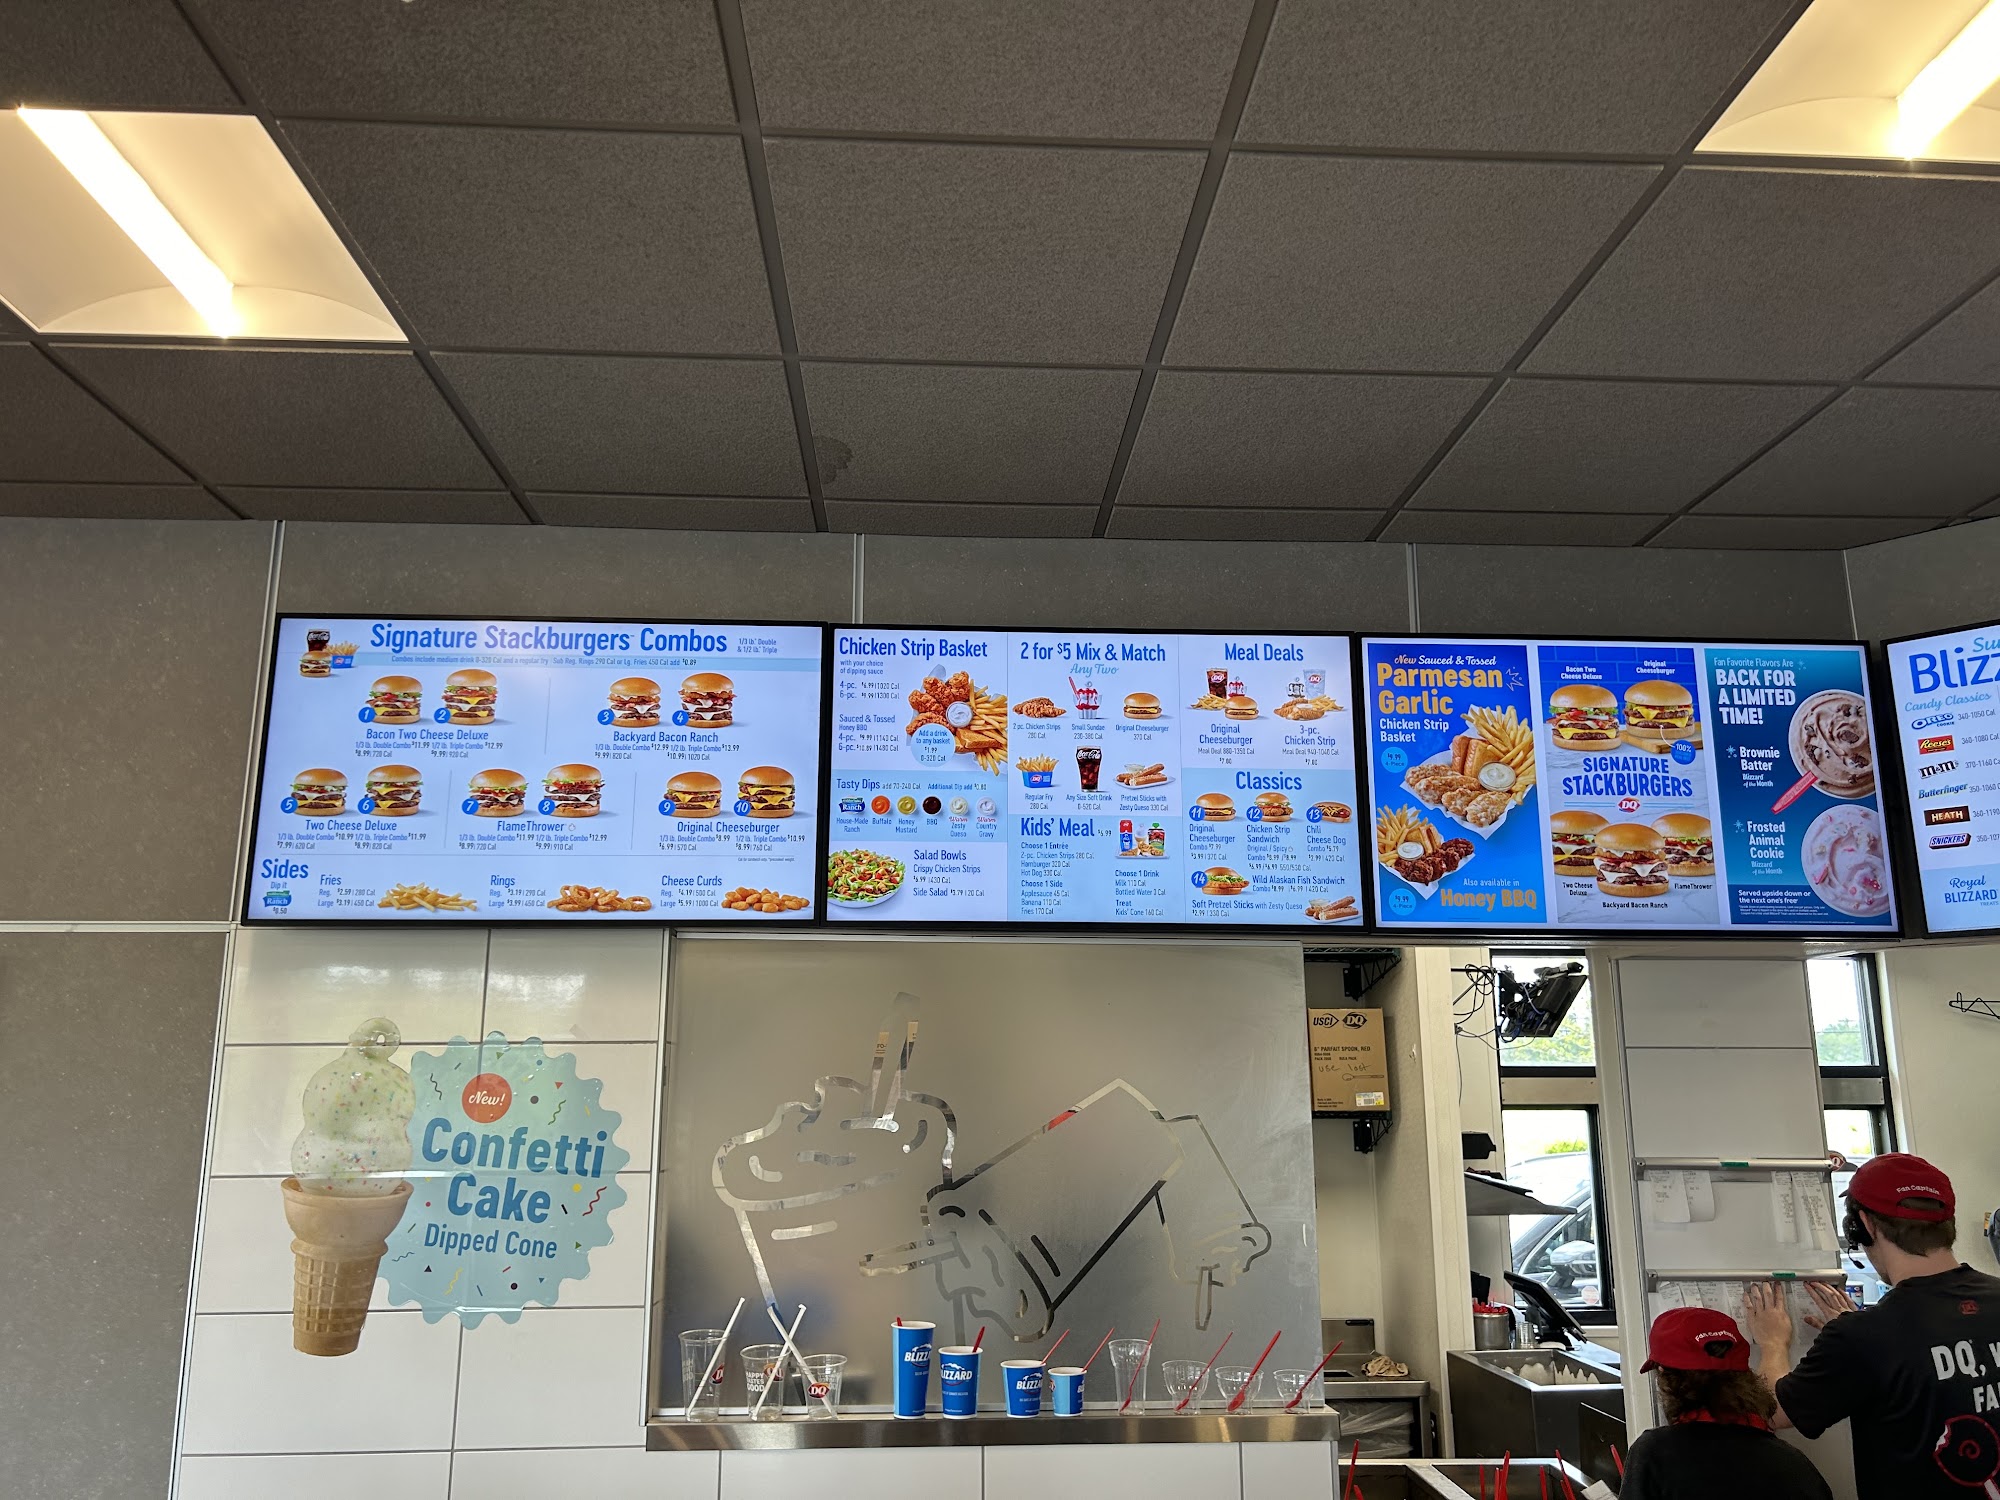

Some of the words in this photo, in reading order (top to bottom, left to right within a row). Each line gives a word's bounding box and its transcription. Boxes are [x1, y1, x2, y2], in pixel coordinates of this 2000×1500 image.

[370, 623, 478, 653] Signature
[484, 625, 630, 656] Stackburgers
[641, 628, 727, 652] Combos
[1972, 637, 2000, 652] Su
[839, 637, 896, 656] Chicken
[901, 638, 935, 660] Strip
[939, 639, 987, 657] Basket
[1021, 642, 1028, 659] 2
[1033, 642, 1053, 660] for
[1057, 643, 1071, 660] $5
[1076, 643, 1100, 661] Mix
[1105, 644, 1117, 661] &
[1122, 643, 1165, 661] Match
[1225, 643, 1259, 661] Meal
[1263, 643, 1303, 661] Deals
[1394, 655, 1417, 664] New
[1418, 655, 1453, 665] Sauced
[1455, 656, 1464, 665] &
[1465, 656, 1496, 666] Tossed
[1714, 658, 1726, 666] Fan
[1726, 658, 1754, 667] Favorite
[1756, 659, 1780, 667] Flavors
[1782, 659, 1793, 667] Are
[847, 668, 866, 676] dipping
[1070, 663, 1093, 678] Any
[1094, 664, 1119, 674] Two
[1377, 662, 1503, 688] Parmesan
[1716, 669, 1761, 686] BACK
[1764, 670, 1796, 686] FOR
[1379, 689, 1453, 715] Garlic
[1719, 688, 1730, 705] A
[1733, 689, 1795, 706] LIMITED
[1905, 698, 1942, 712] Candy
[1946, 692, 1991, 703] Classics
[839, 714, 864, 723] Sauced
[865, 715, 871, 723] &
[873, 715, 895, 723] Tossed
[1719, 707, 1764, 725] TIME!
[1912, 713, 1954, 730] OREO
[1211, 724, 1240, 735] Original
[1299, 725, 1320, 737] 3-pc.
[1380, 718, 1421, 730] Chicken
[1424, 719, 1449, 732] Strip
[366, 729, 395, 739] Bacon
[398, 729, 417, 739] Two
[420, 729, 453, 740] Cheese
[457, 730, 488, 740] Deluxe
[613, 731, 656, 744] Backyard
[659, 732, 686, 742] Bacon
[690, 732, 718, 742] Ranch
[1200, 735, 1252, 746] Cheeseburger
[1380, 731, 1416, 742] Basket
[1285, 736, 1315, 745] Chicken
[1317, 736, 1336, 746] Strip
[1739, 746, 1780, 759] Brownie
[1583, 757, 1669, 773] SIGNATURE
[1741, 759, 1772, 771] Batter
[837, 779, 859, 790] Tasty
[862, 779, 880, 791] Dips
[1236, 771, 1302, 790] Classics
[1562, 773, 1693, 796] STACKBURGERS
[1918, 783, 1968, 799] Butterfinger
[1932, 811, 1963, 822] HEATH
[306, 820, 324, 830] Two
[327, 820, 361, 831] Cheese
[365, 820, 397, 831] Deluxe
[497, 821, 564, 832] FlameThrower
[677, 822, 713, 834] Original
[716, 822, 780, 834] Cheeseburger
[1059, 818, 1095, 836] Meal
[1246, 825, 1273, 833] Chicken
[1274, 825, 1290, 834] Strip
[1747, 821, 1785, 833] Frosted
[1247, 835, 1280, 843] Sandwich
[1749, 834, 1785, 846] Animal
[1931, 834, 1966, 846] SNICKERS
[914, 850, 939, 860] Salad
[941, 850, 967, 861] Bowls
[1750, 848, 1784, 859] Cookie
[261, 858, 309, 879] Sides
[914, 864, 933, 874] Crispy
[935, 865, 960, 873] Chicken
[962, 865, 981, 874] Strips
[320, 874, 342, 885] Fries
[491, 874, 515, 888] Rings
[662, 875, 694, 886] Cheese
[697, 875, 722, 886] Curds
[1252, 875, 1267, 884] Wild
[1270, 875, 1296, 884] Alaskan
[1298, 876, 1310, 884] Fish
[1312, 876, 1345, 885] Sandwich
[1463, 878, 1477, 887] Also
[1480, 879, 1511, 887] available
[1513, 879, 1519, 887] in
[1950, 875, 1986, 890] Royal
[319, 889, 332, 897] Reg.
[337, 888, 351, 896] $2.59
[913, 888, 927, 897] Side
[929, 888, 948, 897] Salad
[1944, 889, 1998, 903] BLIZZARD
[1192, 900, 1206, 909] Soft
[1208, 900, 1232, 909] Pretzel
[1234, 901, 1254, 909] Sticks
[1441, 888, 1496, 912] Honey
[1501, 889, 1537, 910] BBQ
[1313, 1017, 1333, 1025] USCI
[1346, 1015, 1364, 1026] DQ
[468, 1091, 507, 1107] New!
[421, 1117, 608, 1179] Confetti
[1911, 1185, 1940, 1195] Captain
[447, 1172, 551, 1224] Cake
[424, 1223, 498, 1256] Dipped
[505, 1231, 558, 1259] Cone
[941, 1371, 972, 1380] LIZZARD
[811, 1387, 826, 1395] DQ
[1973, 1382, 2000, 1413] FA
